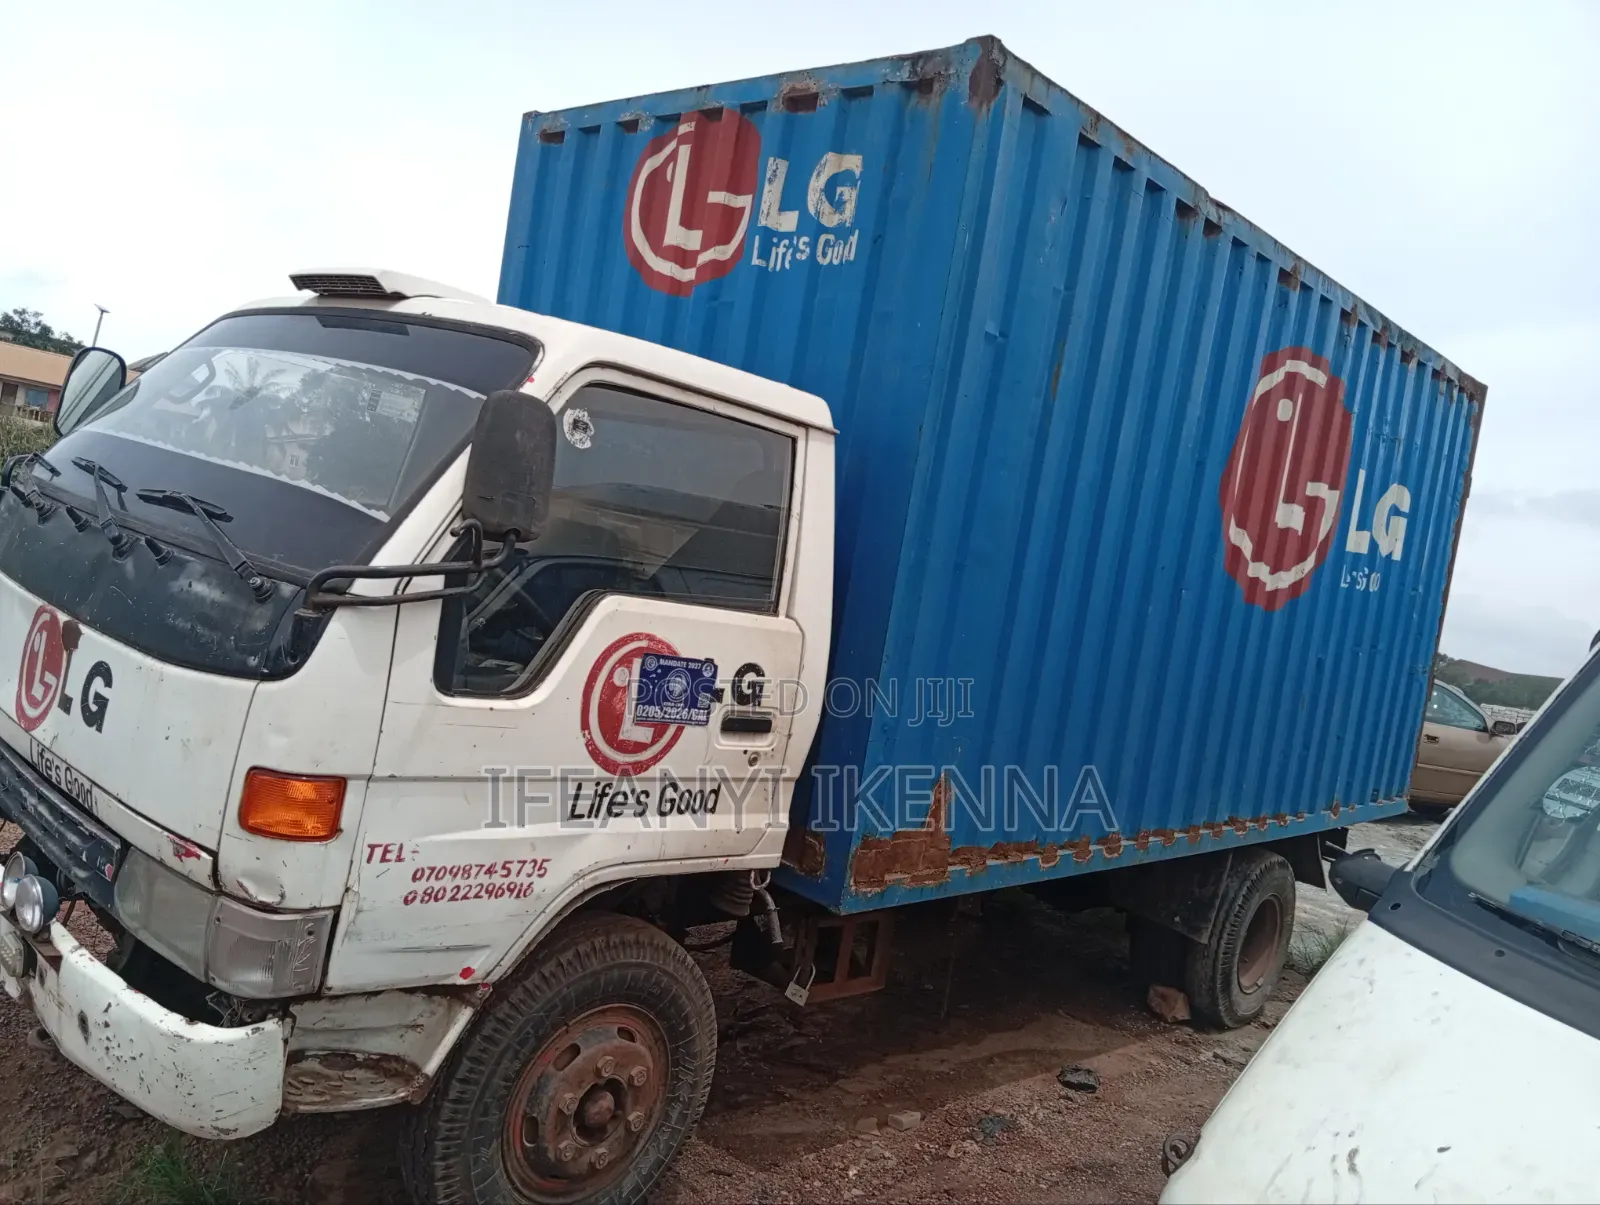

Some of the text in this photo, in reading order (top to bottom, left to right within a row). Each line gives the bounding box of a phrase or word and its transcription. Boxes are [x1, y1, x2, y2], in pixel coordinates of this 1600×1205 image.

[757, 151, 863, 233] LG
[1345, 467, 1412, 561] LG
[58, 648, 114, 734] LG
[29, 737, 94, 814] Life's Good
[567, 780, 722, 821] Life's Good
